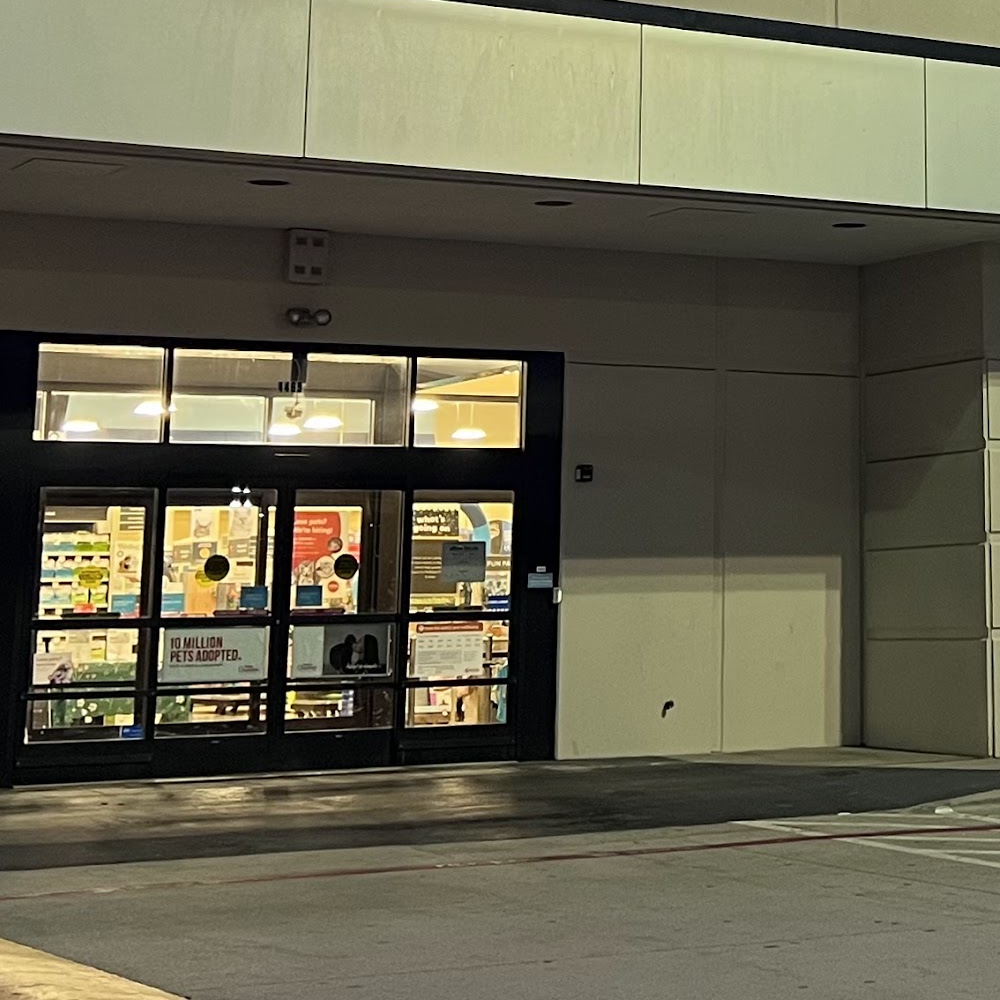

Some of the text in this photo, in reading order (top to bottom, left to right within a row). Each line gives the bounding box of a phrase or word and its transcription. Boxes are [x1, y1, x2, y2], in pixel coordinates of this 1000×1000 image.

[170, 636, 223, 649] 10 MILLION
[170, 649, 242, 662] PETS ADOPTED.
